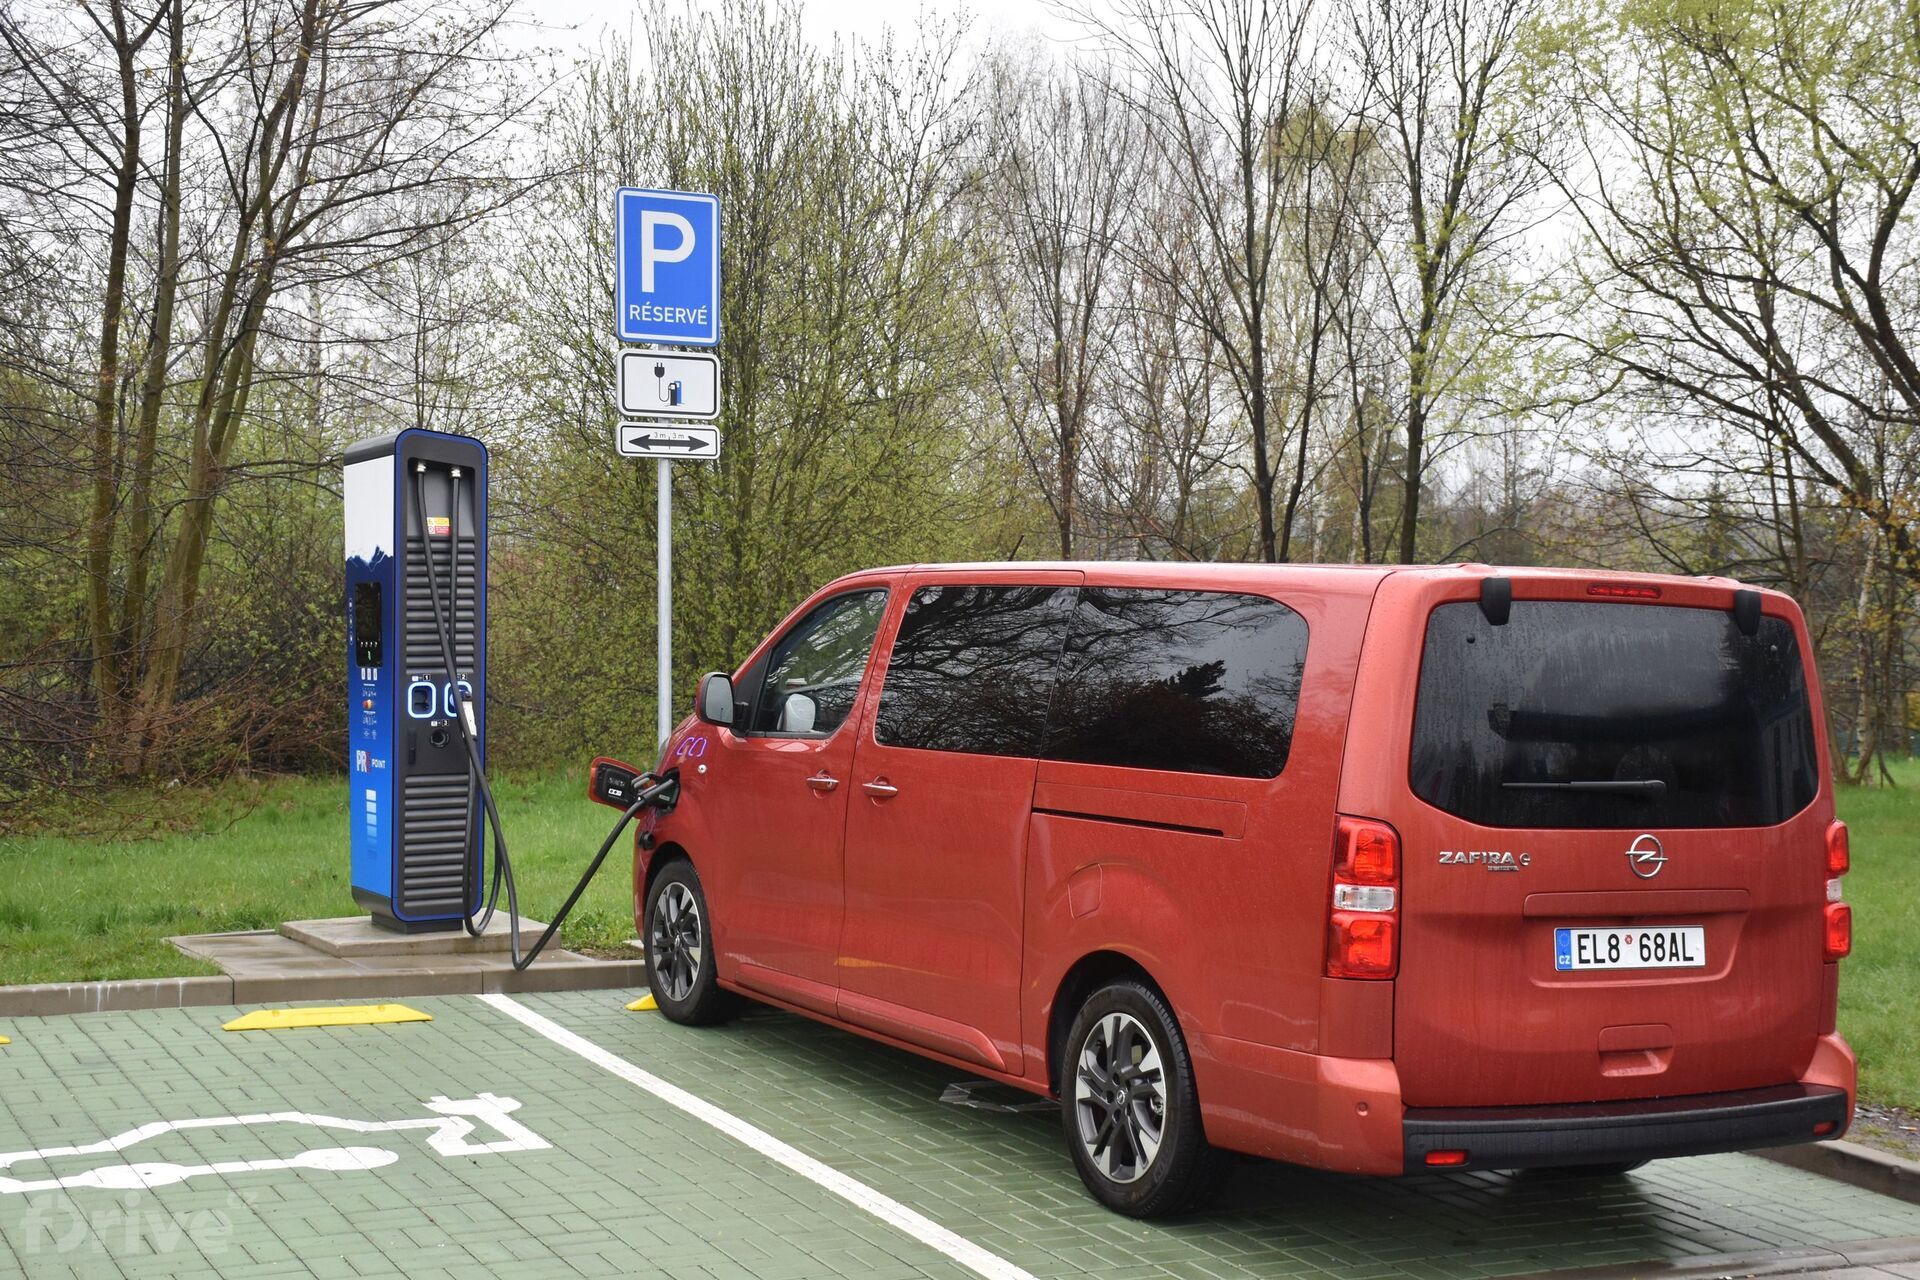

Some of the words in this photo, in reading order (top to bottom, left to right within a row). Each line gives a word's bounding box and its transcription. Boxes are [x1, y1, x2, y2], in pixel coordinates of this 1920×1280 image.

[641, 210, 695, 293] P
[629, 301, 708, 325] RÉSERVÉ
[356, 750, 371, 773] PRE
[371, 759, 386, 769] POINT
[1438, 851, 1515, 865] ZAFIRA
[1559, 955, 1571, 965] CZ
[1577, 933, 1620, 964] EL8
[1639, 932, 1694, 962] 68AL
